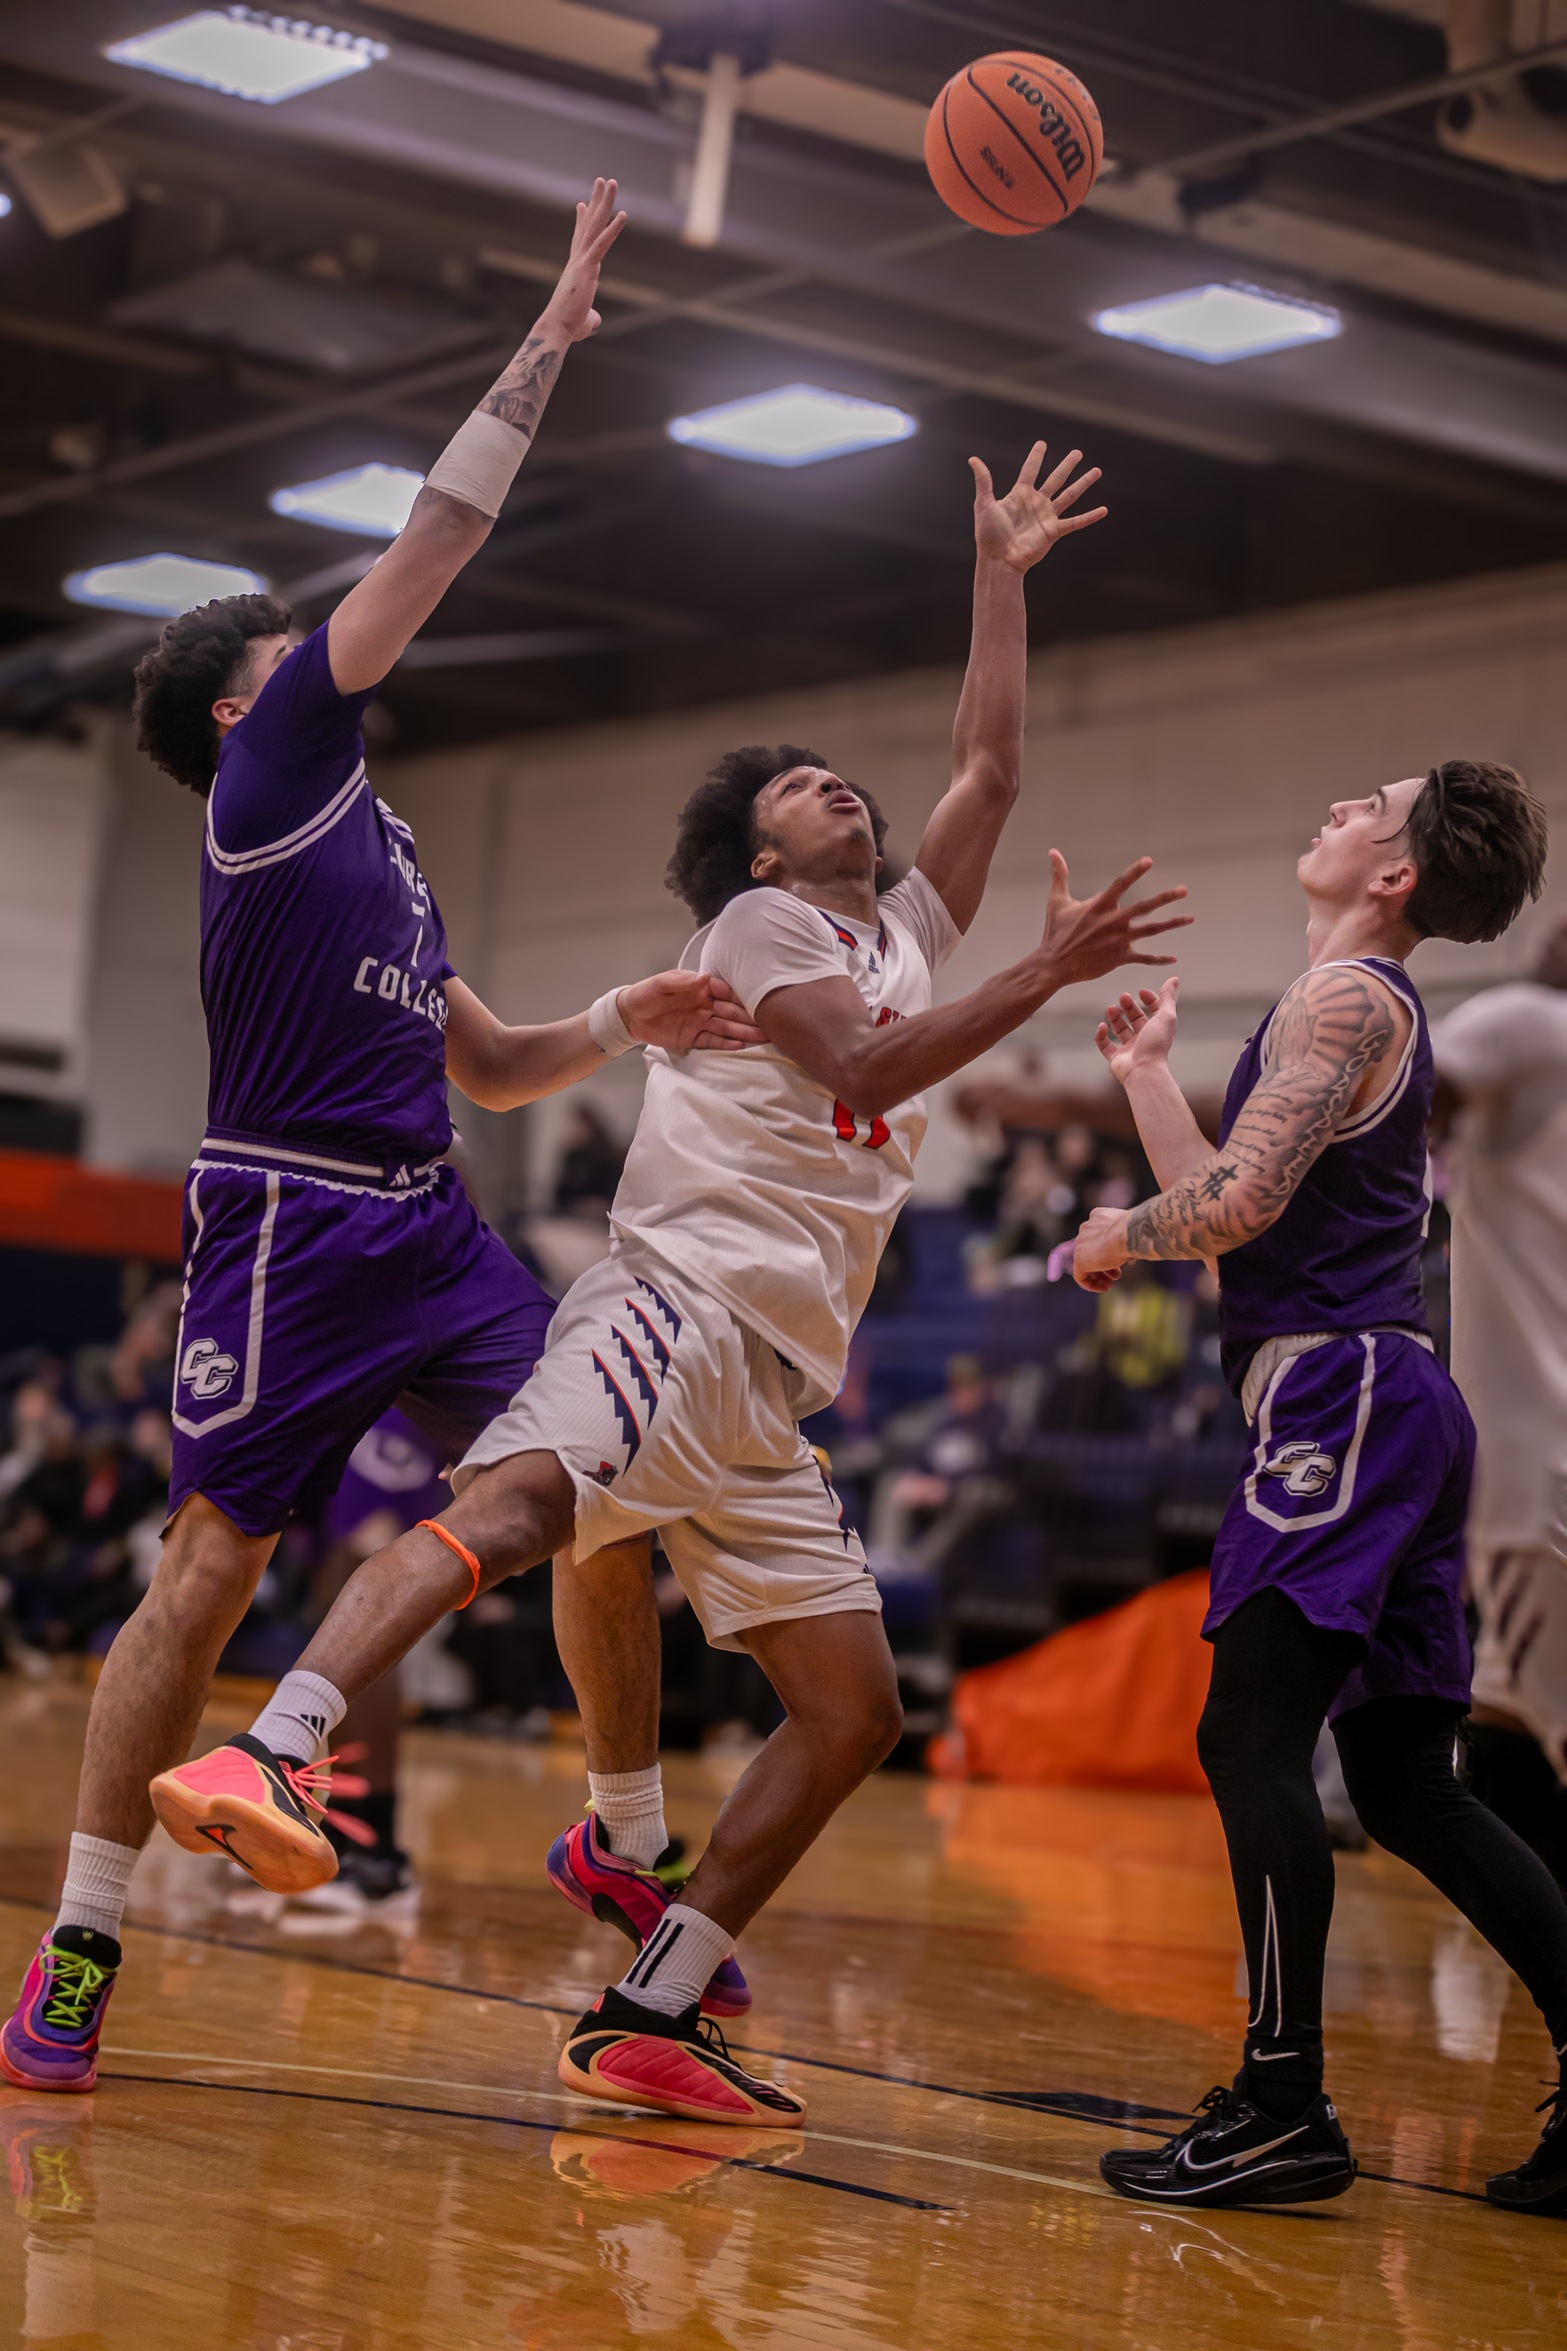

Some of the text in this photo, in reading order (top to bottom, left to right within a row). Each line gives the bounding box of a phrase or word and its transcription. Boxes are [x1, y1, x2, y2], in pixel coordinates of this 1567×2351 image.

[1006, 72, 1085, 182] Wilson
[180, 1337, 239, 1400] CC
[1262, 1441, 1337, 1497] CC
